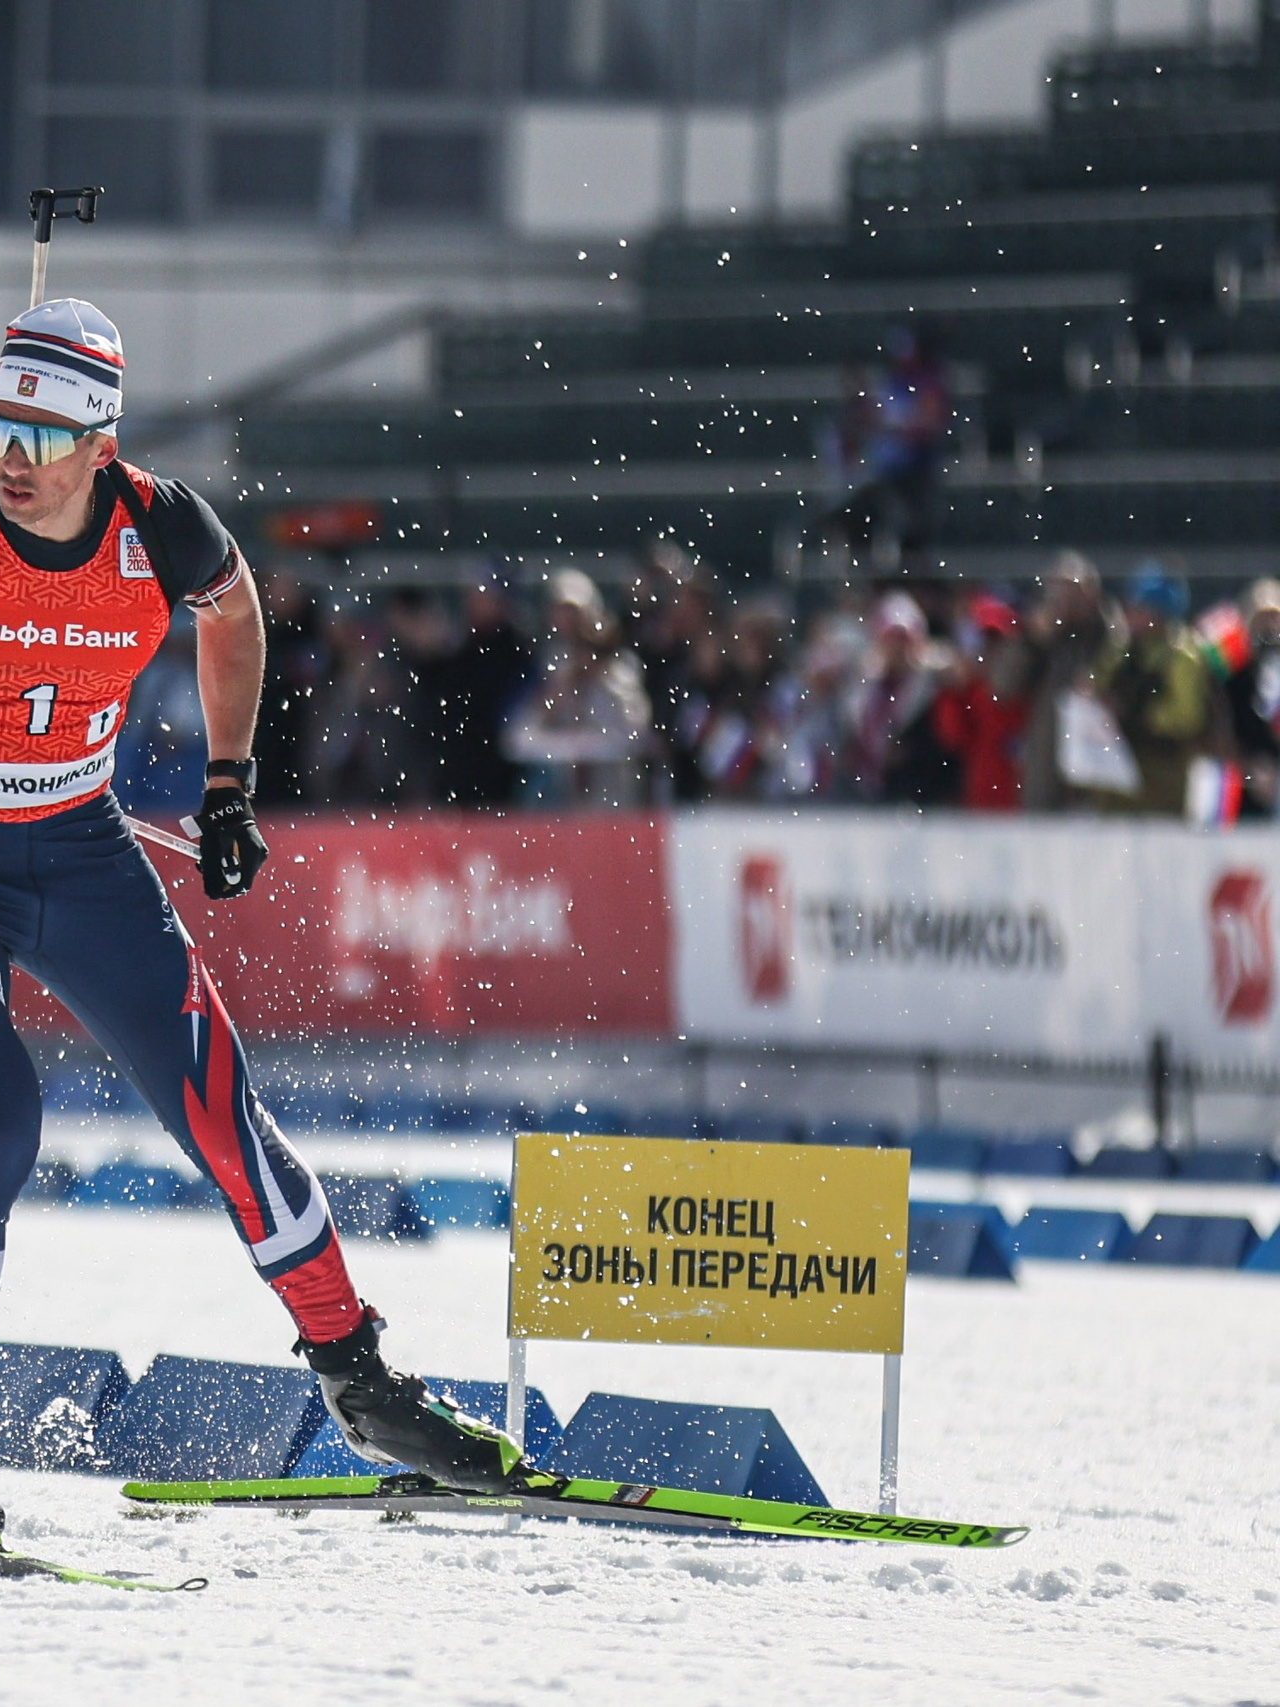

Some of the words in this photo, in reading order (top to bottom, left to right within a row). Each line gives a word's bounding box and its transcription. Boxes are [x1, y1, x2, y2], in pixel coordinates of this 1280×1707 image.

[127, 545, 147, 558] 202
[65, 623, 138, 648] Банк
[21, 683, 59, 736] 1
[209, 803, 244, 821] MOAX
[647, 1195, 775, 1246] КОНЕЦ
[542, 1243, 657, 1287] ЗОНЫ
[671, 1249, 876, 1299] ПЕРЕДАЧИ
[466, 1498, 523, 1507] FISCHER
[792, 1511, 960, 1540] FISCHER
